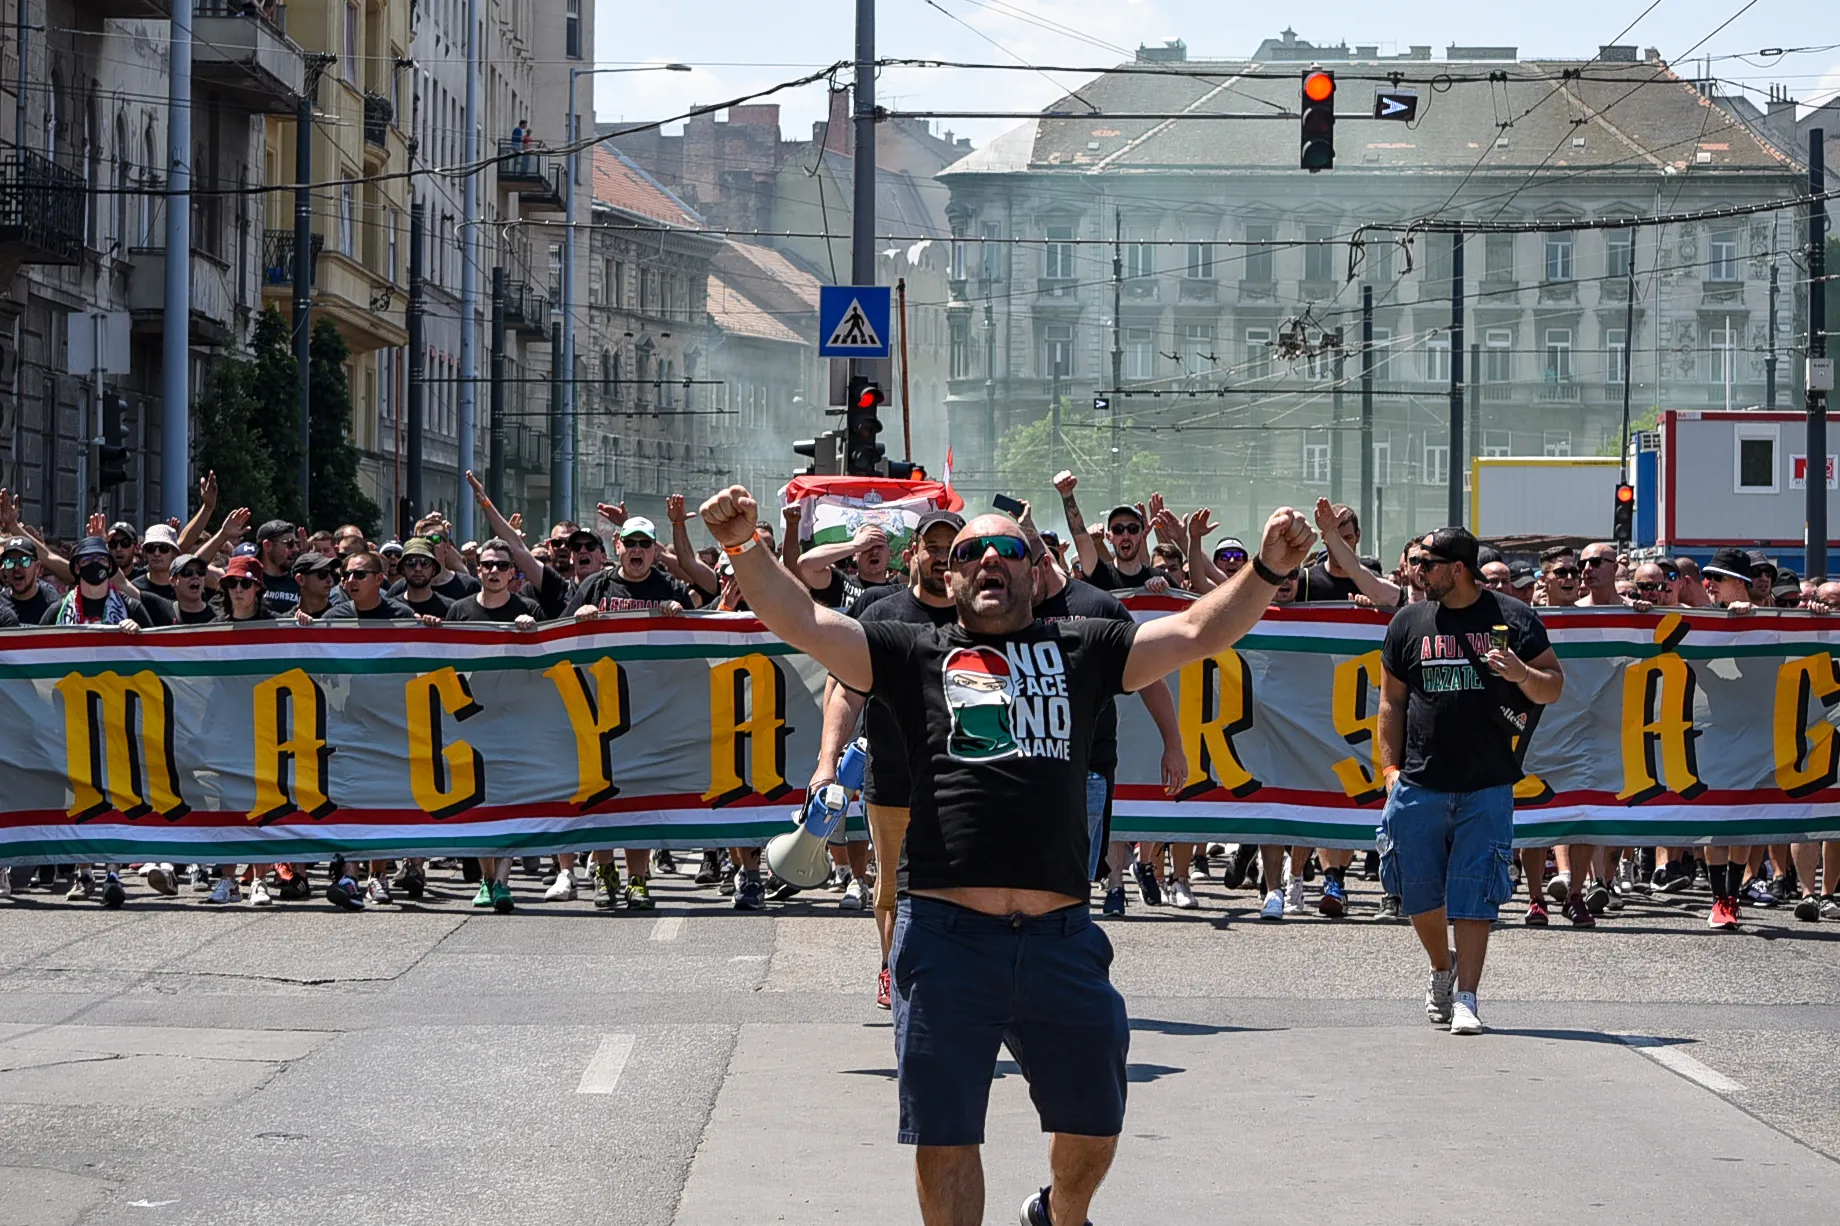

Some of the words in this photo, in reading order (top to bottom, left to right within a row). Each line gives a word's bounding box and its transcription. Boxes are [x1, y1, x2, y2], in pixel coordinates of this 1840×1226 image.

[1006, 641, 1065, 680] NO
[1421, 636, 1432, 660] A
[1013, 675, 1069, 698] FACE
[54, 612, 1840, 825] MAGYARSÁG
[1015, 696, 1071, 739] NO
[1017, 739, 1070, 761] NAME
